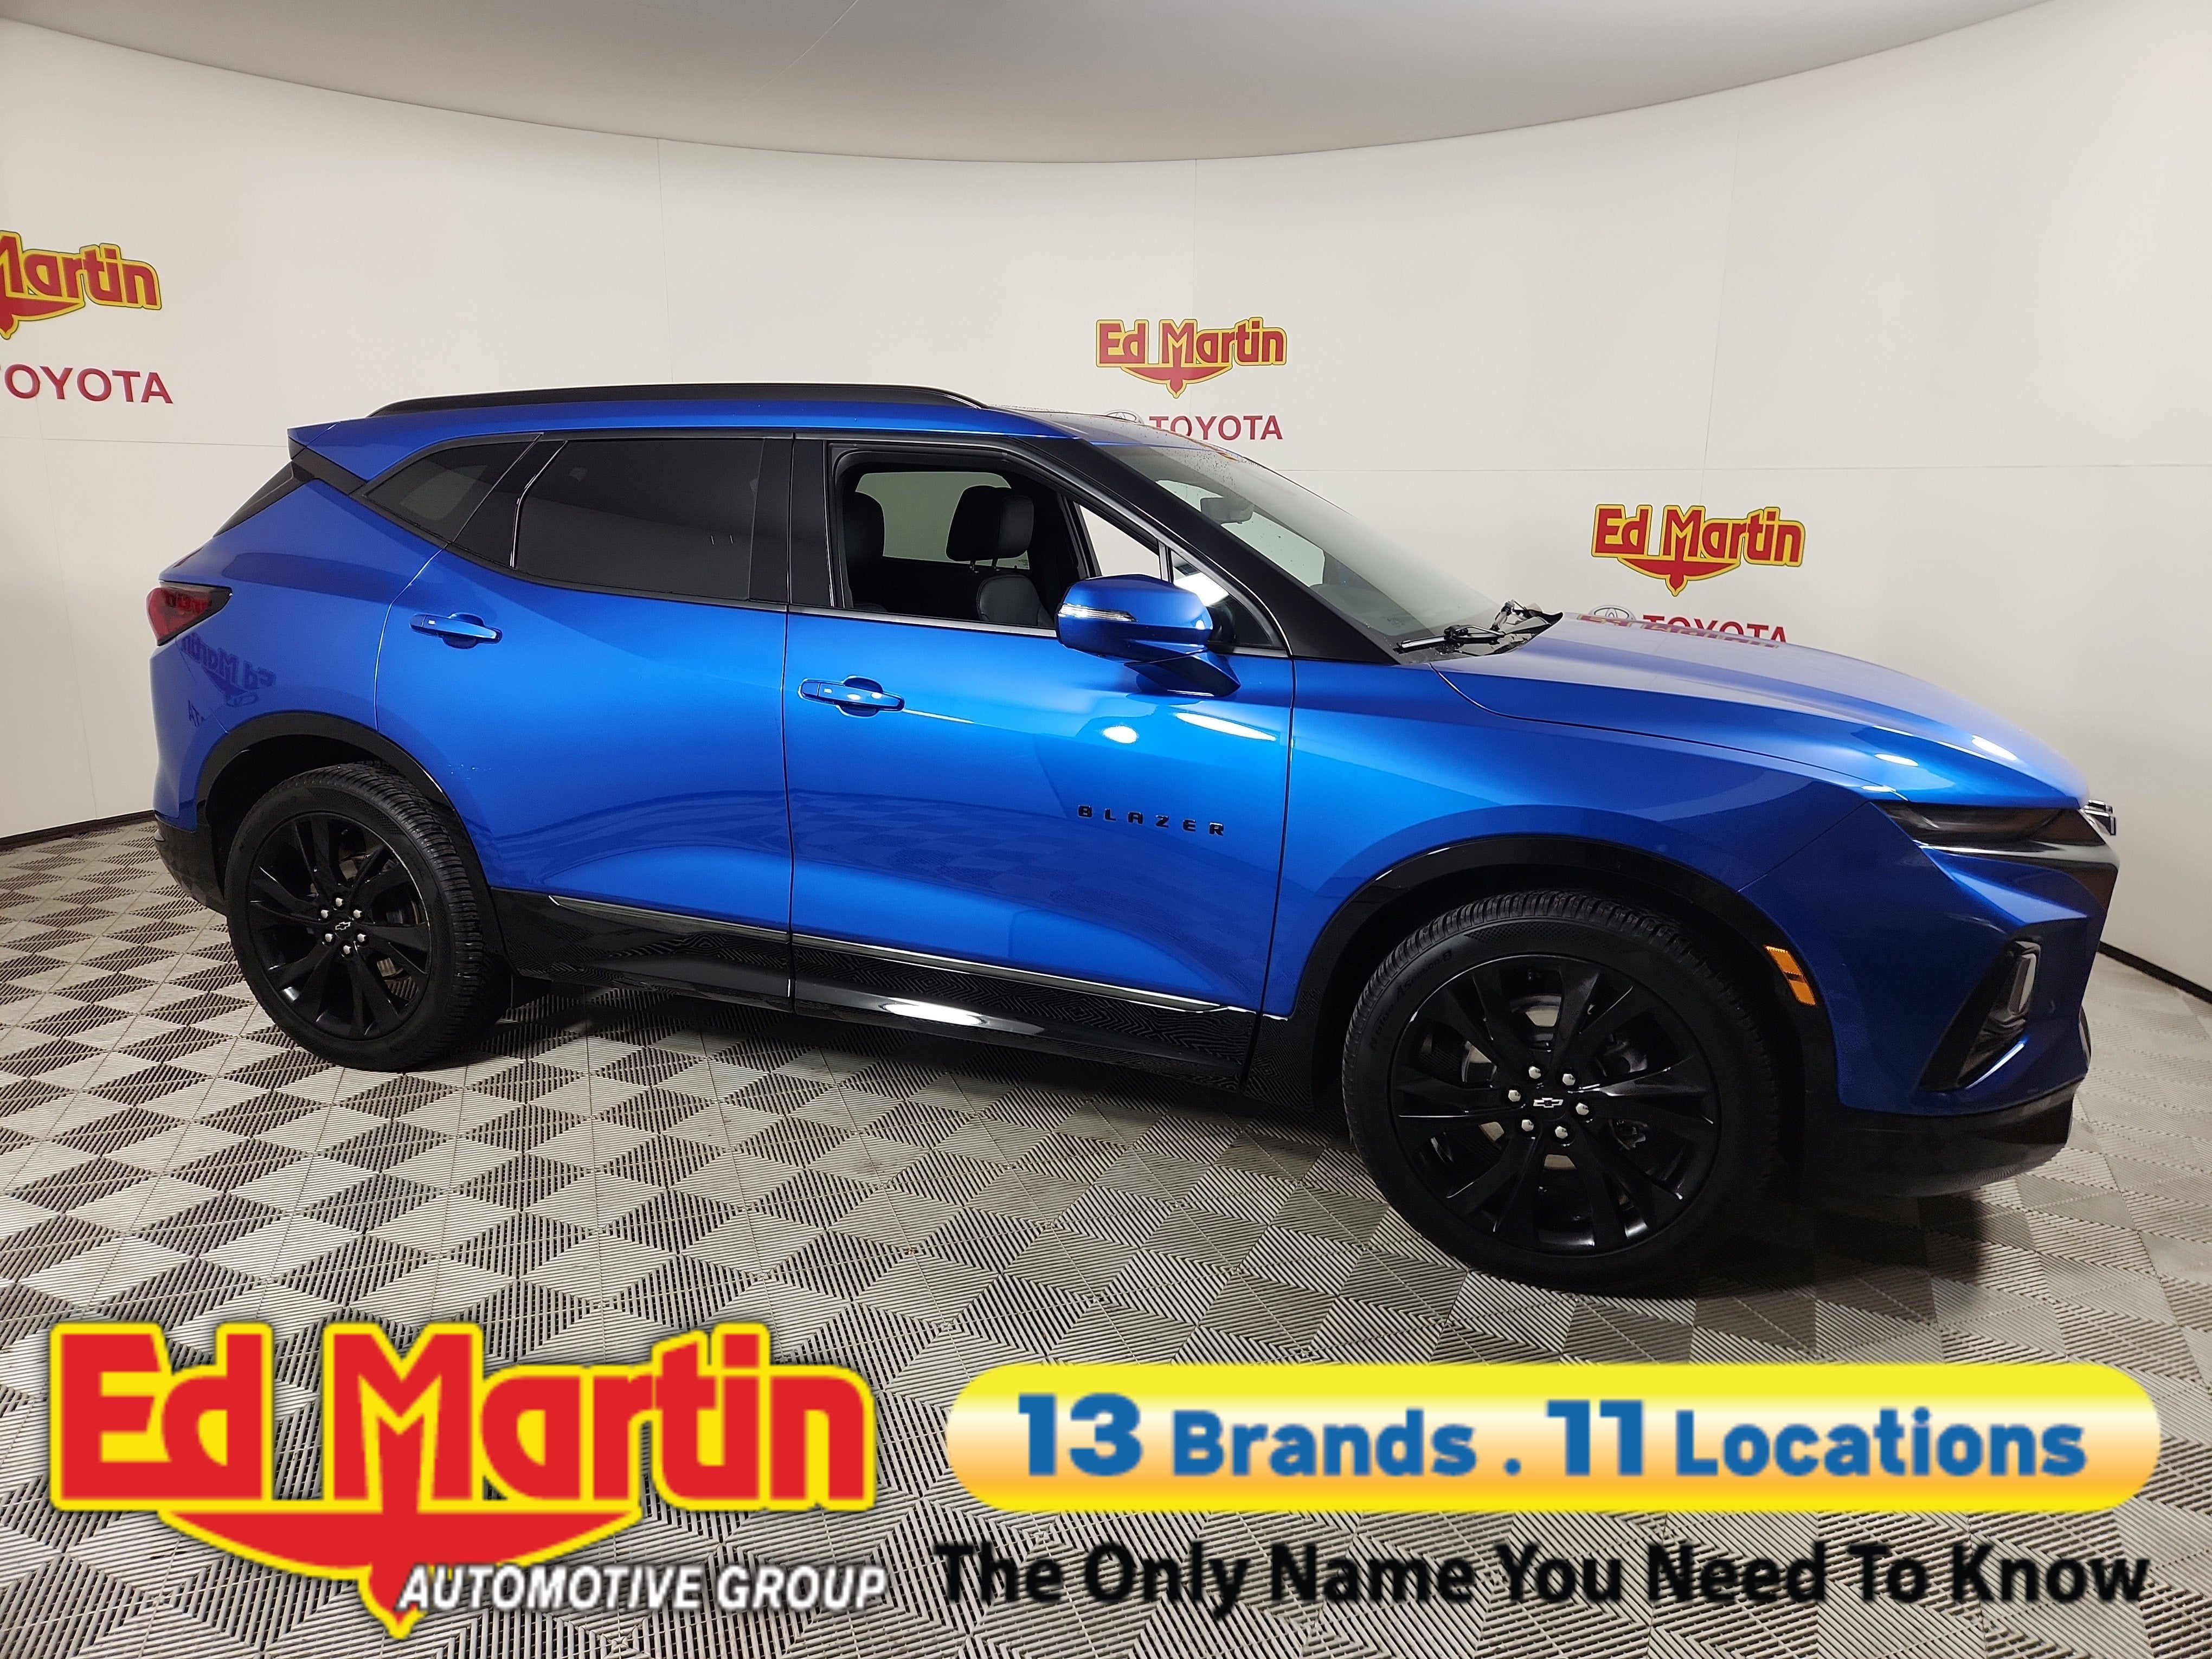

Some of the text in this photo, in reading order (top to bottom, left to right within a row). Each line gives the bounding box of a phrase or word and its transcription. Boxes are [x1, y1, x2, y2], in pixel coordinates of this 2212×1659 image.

[1098, 321, 1283, 364] Ed Martin
[0, 364, 173, 404] OYOTA
[1595, 508, 1803, 562] Ed Martin
[1078, 805, 1225, 836] BLAZER
